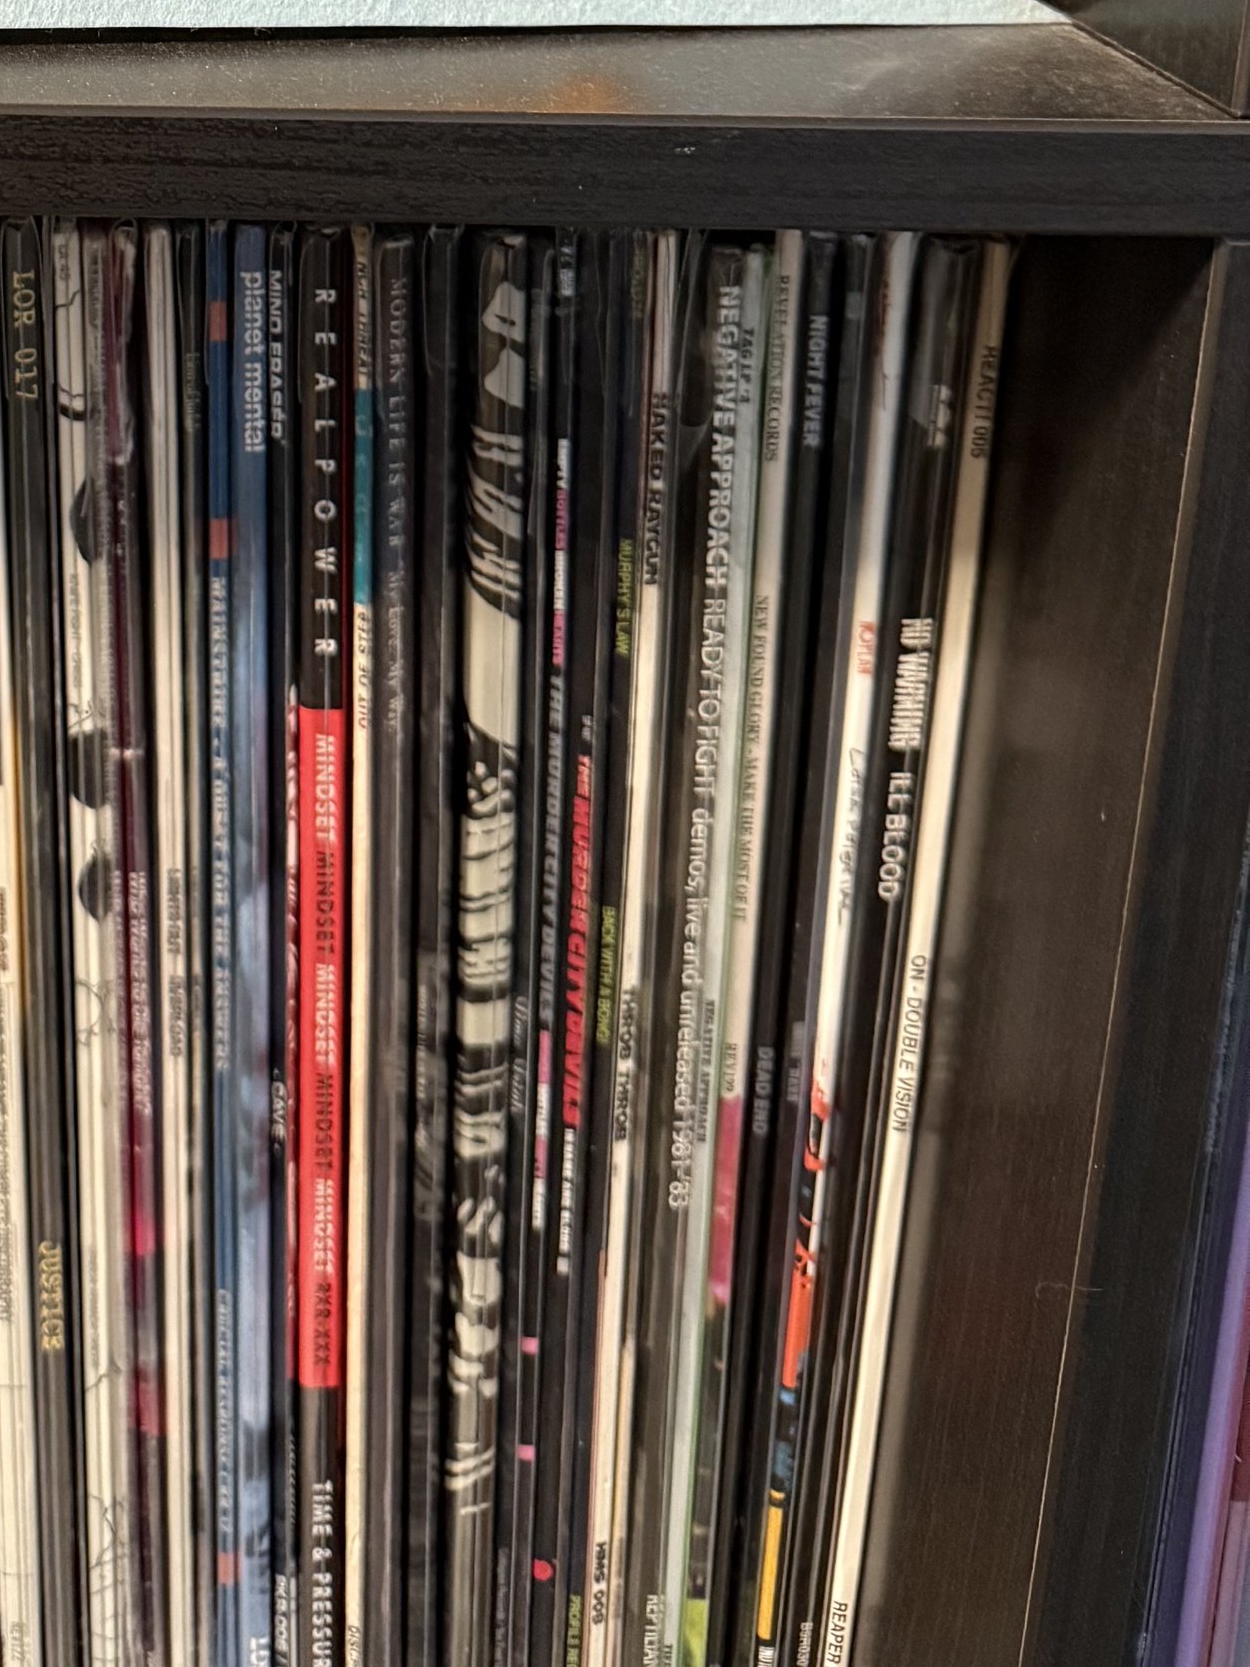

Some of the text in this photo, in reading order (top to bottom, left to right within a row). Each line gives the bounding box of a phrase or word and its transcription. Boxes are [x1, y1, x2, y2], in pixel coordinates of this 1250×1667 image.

[241, 272, 265, 453] planet mental
[388, 278, 407, 547] MODERN LIFE IS WAR
[802, 314, 829, 446] NIGHT FEVER
[971, 426, 988, 458] 005
[210, 576, 227, 730] MAINSTRIKE
[548, 675, 565, 728] THE
[673, 285, 741, 1112] NEGATIVE APPROACH READY TO FIGHT demos, live and unreleased
[732, 274, 791, 922] REVELATION RECORDS NEW FOUND GLORY MAKE THE MOST OF IT
[12, 271, 64, 1352] LOR 017 JUSTICE
[544, 731, 563, 853] MURDER
[599, 538, 635, 982] MURPHY'S LAW WITH
[615, 391, 671, 1141] NAKED RAYGUN THROB THROB
[876, 617, 934, 901] NO WARNING ILL BLOOD
[538, 926, 557, 1026] DEVILS
[542, 856, 559, 922] CITY
[560, 754, 592, 1128] THE MURDER CITY DEVILS
[311, 734, 335, 1563] MINDSET MINDSET MINDSET MINDSET MINDSET TIME &
[697, 999, 717, 1143] NEGATIVE APPROACH
[756, 1046, 776, 1097] DEAD
[826, 954, 929, 1664] ON DOUBLE VISION REAPER
